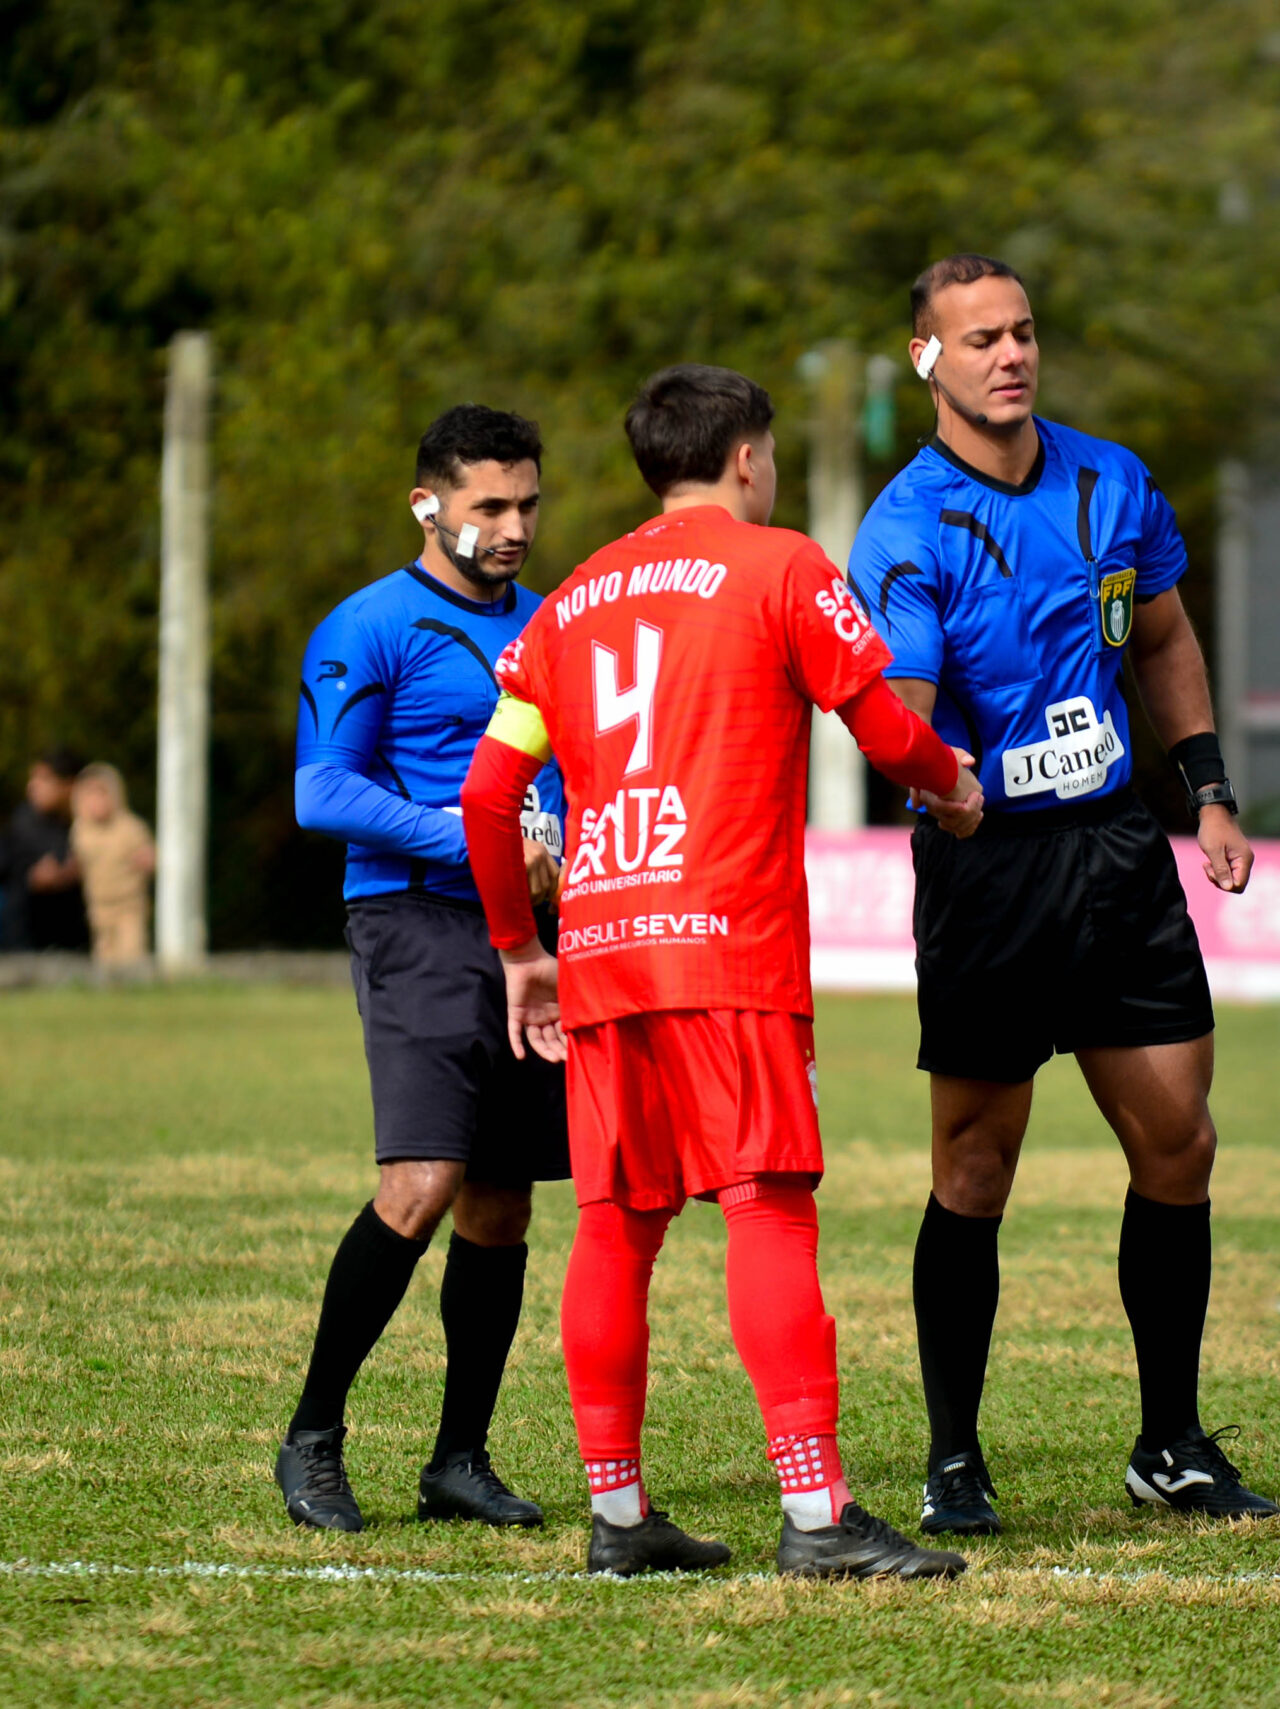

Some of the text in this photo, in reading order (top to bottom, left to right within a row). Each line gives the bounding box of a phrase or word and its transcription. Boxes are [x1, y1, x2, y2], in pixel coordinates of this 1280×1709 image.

[555, 558, 727, 630] NOVO MUNDO
[1103, 580, 1132, 603] FPF
[591, 618, 663, 780] 4
[1063, 771, 1103, 791] HOMEM
[558, 914, 728, 954] CONSULT SEVEN
[659, 936, 707, 945] HUMANOS
